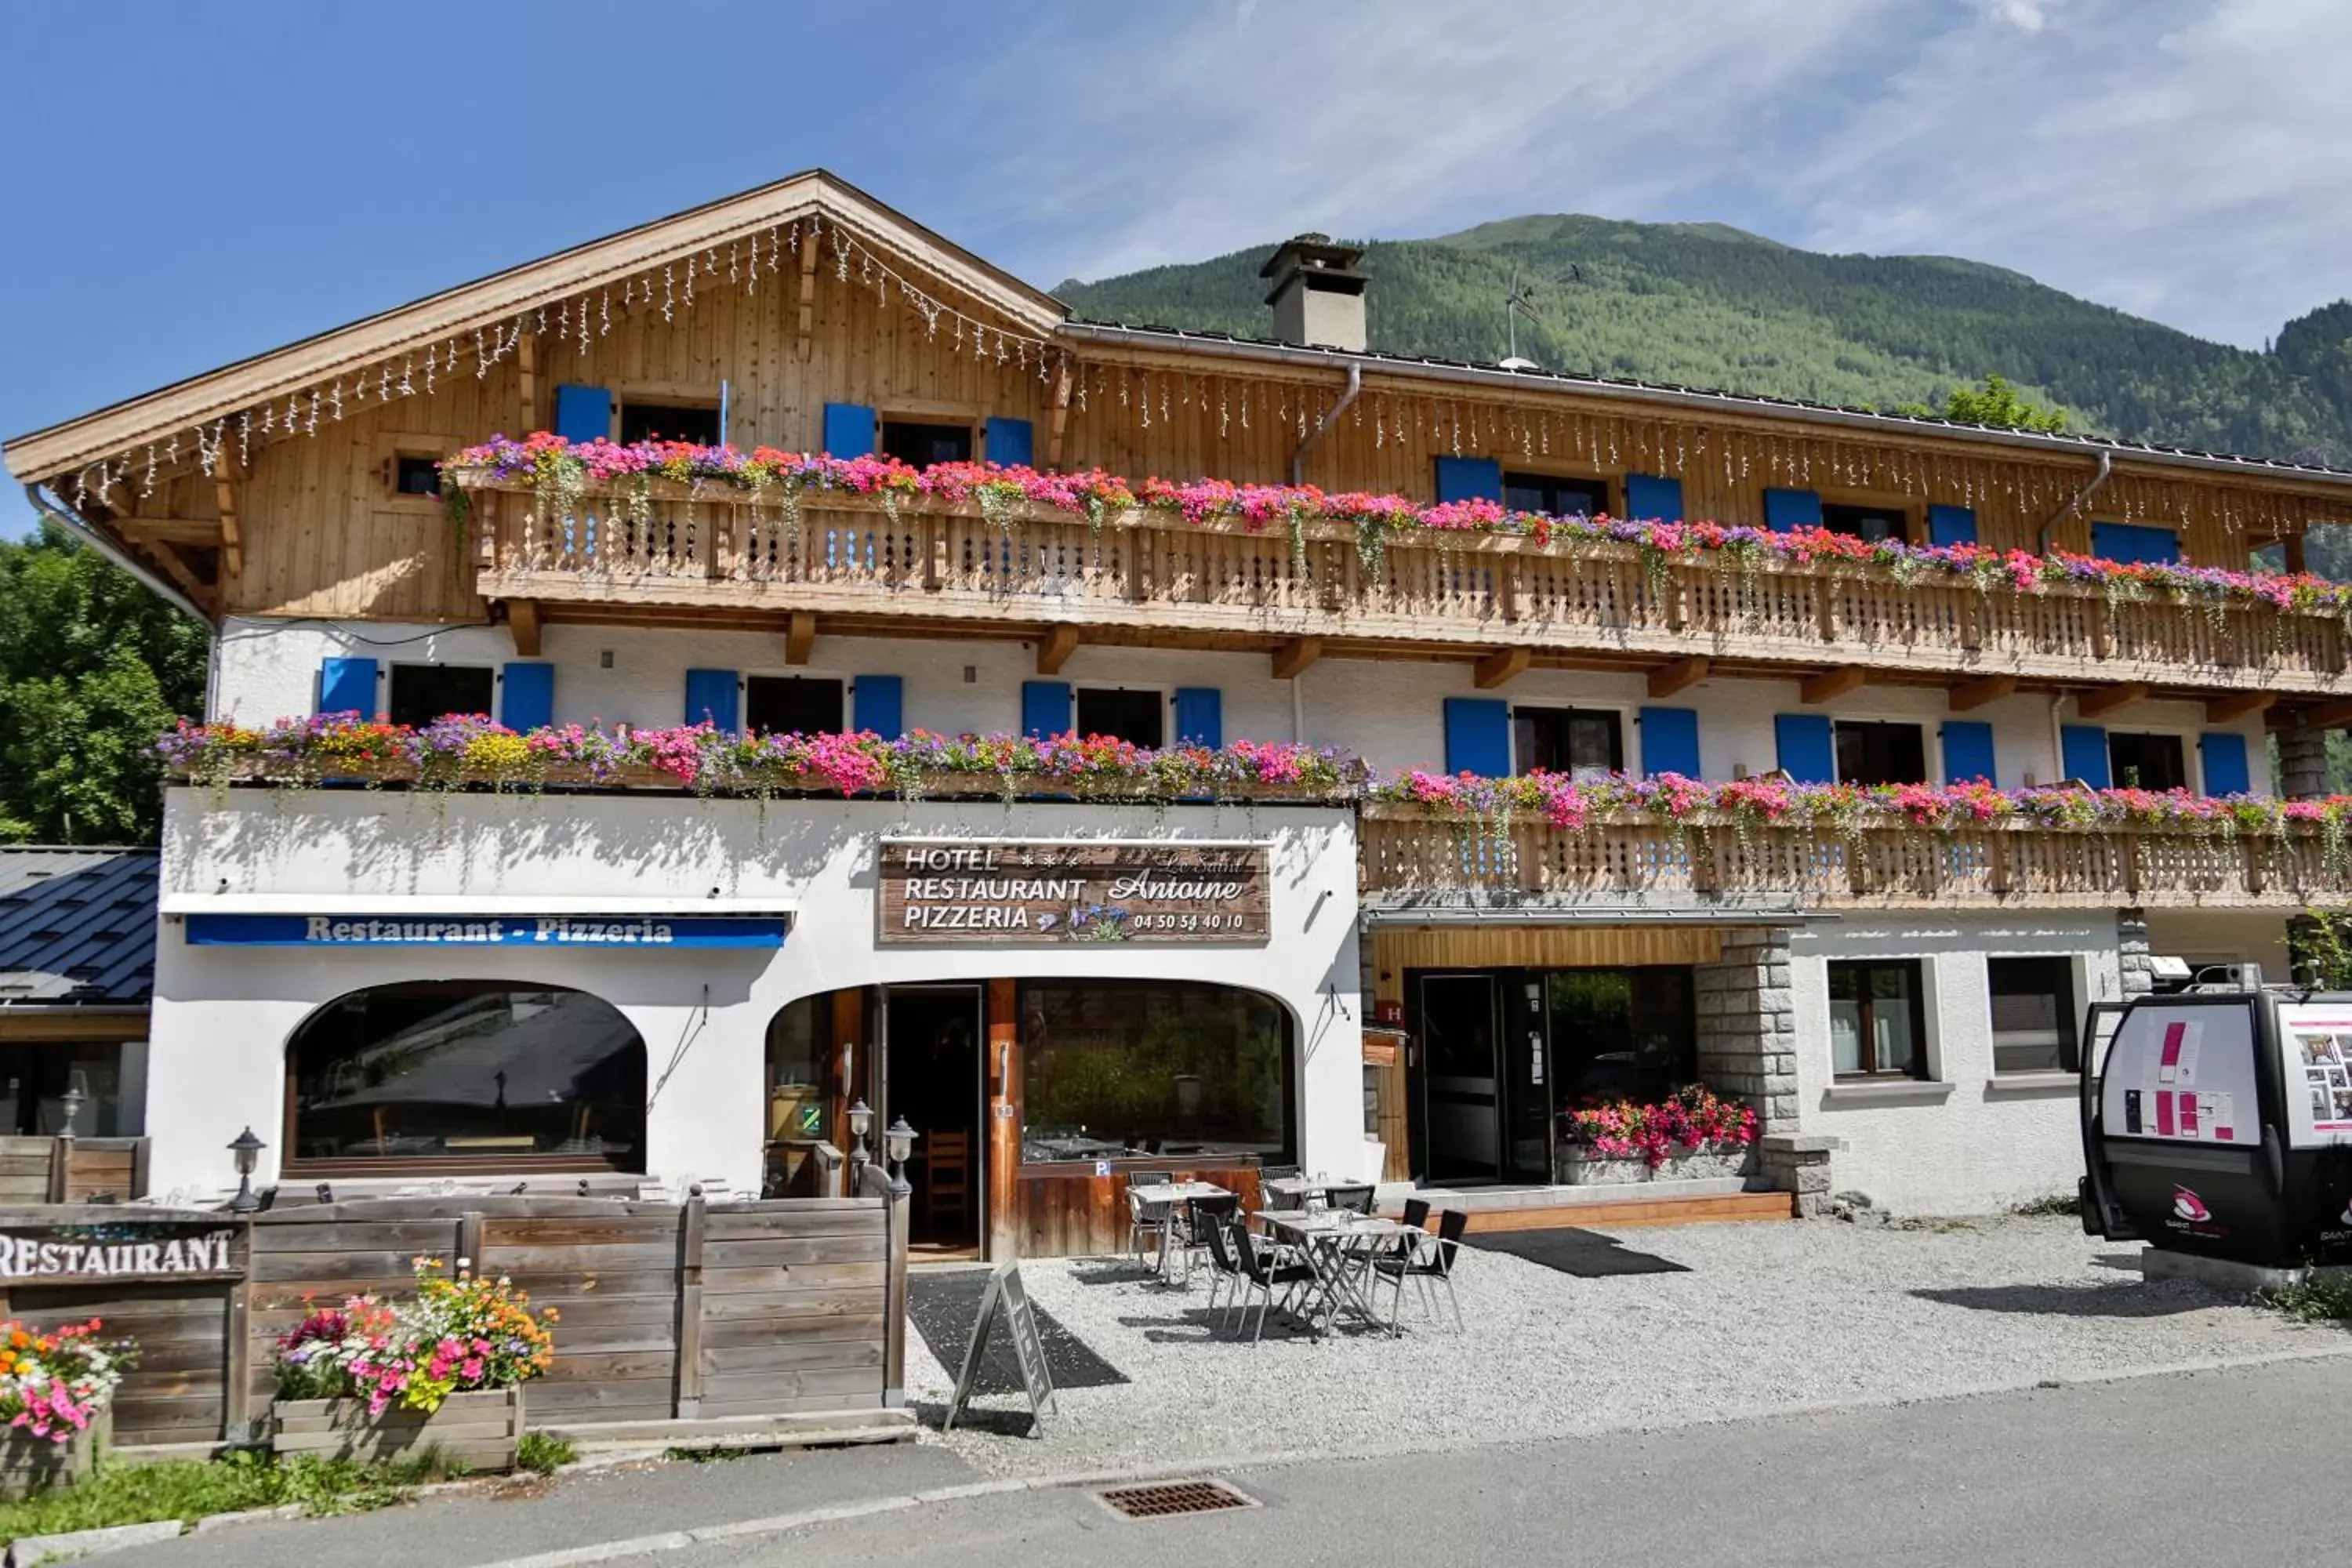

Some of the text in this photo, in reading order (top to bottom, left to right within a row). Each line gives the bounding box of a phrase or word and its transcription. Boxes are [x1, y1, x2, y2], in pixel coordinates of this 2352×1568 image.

[904, 849, 1000, 871] HOTEL
[1195, 855, 1245, 873] Saint
[904, 878, 1087, 900] RESTAURANT
[1108, 867, 1243, 900] Antoine
[904, 906, 1029, 928] PIZZERIA
[1135, 915, 1152, 928] 04
[1157, 915, 1175, 928] 50
[1202, 915, 1221, 928] 40
[1227, 915, 1243, 928] 10
[305, 916, 504, 942] Restaurant
[534, 918, 673, 942] Pizzeria
[1388, 1007, 1402, 1021] H
[0, 1229, 233, 1276] RESTAURANT
